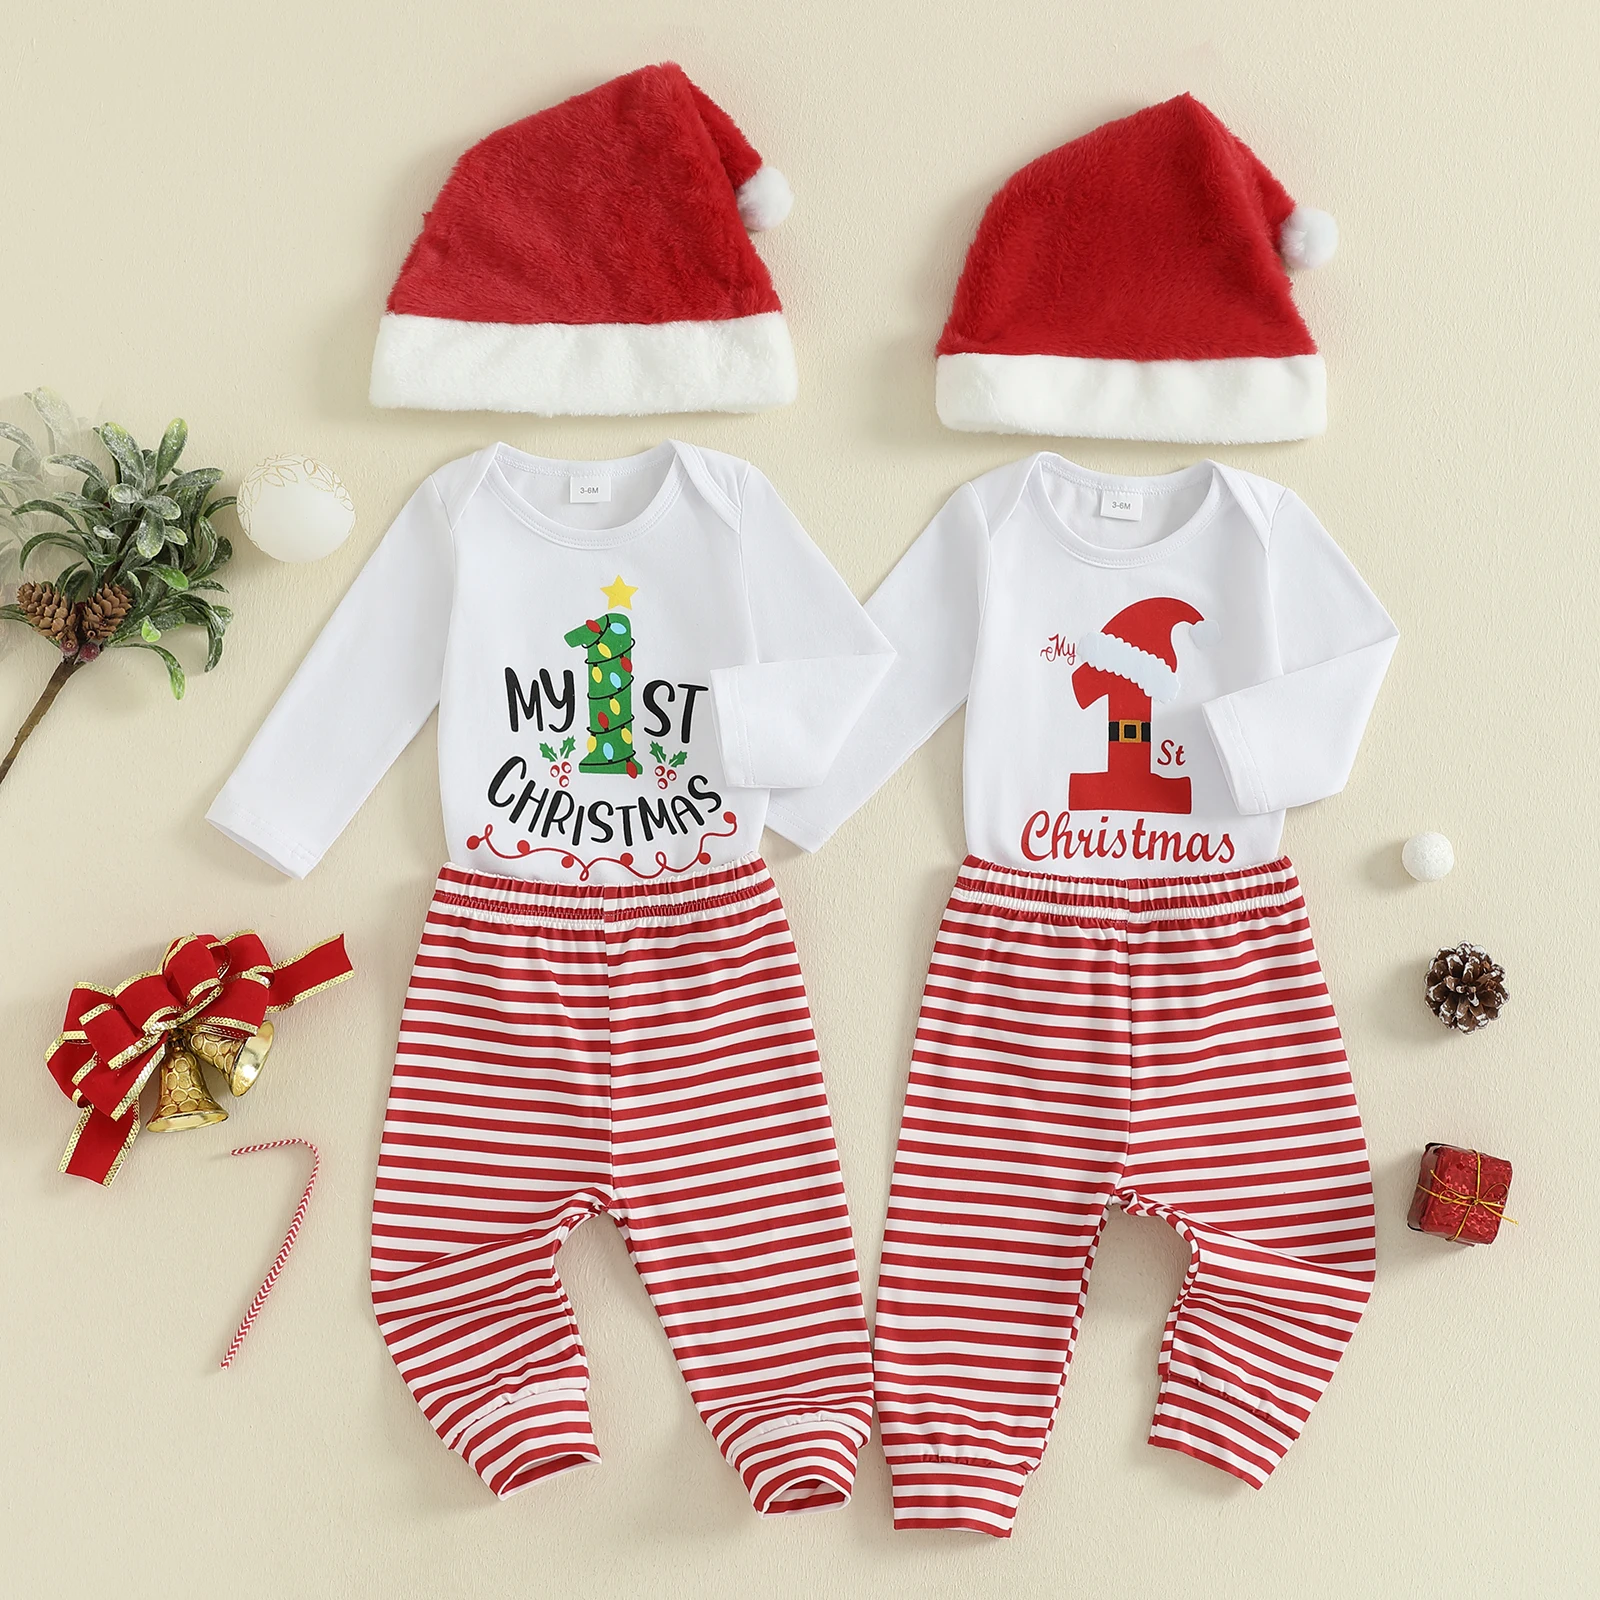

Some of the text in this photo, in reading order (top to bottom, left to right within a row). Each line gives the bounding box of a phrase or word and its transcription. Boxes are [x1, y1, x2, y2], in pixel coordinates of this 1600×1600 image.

[579, 486, 599, 495] 3-6M
[1111, 501, 1131, 510] 3-6M
[1040, 634, 1076, 666] My
[505, 667, 575, 732] MY
[488, 756, 722, 846] CHRISTMAS
[1020, 810, 1236, 864] Christmas
